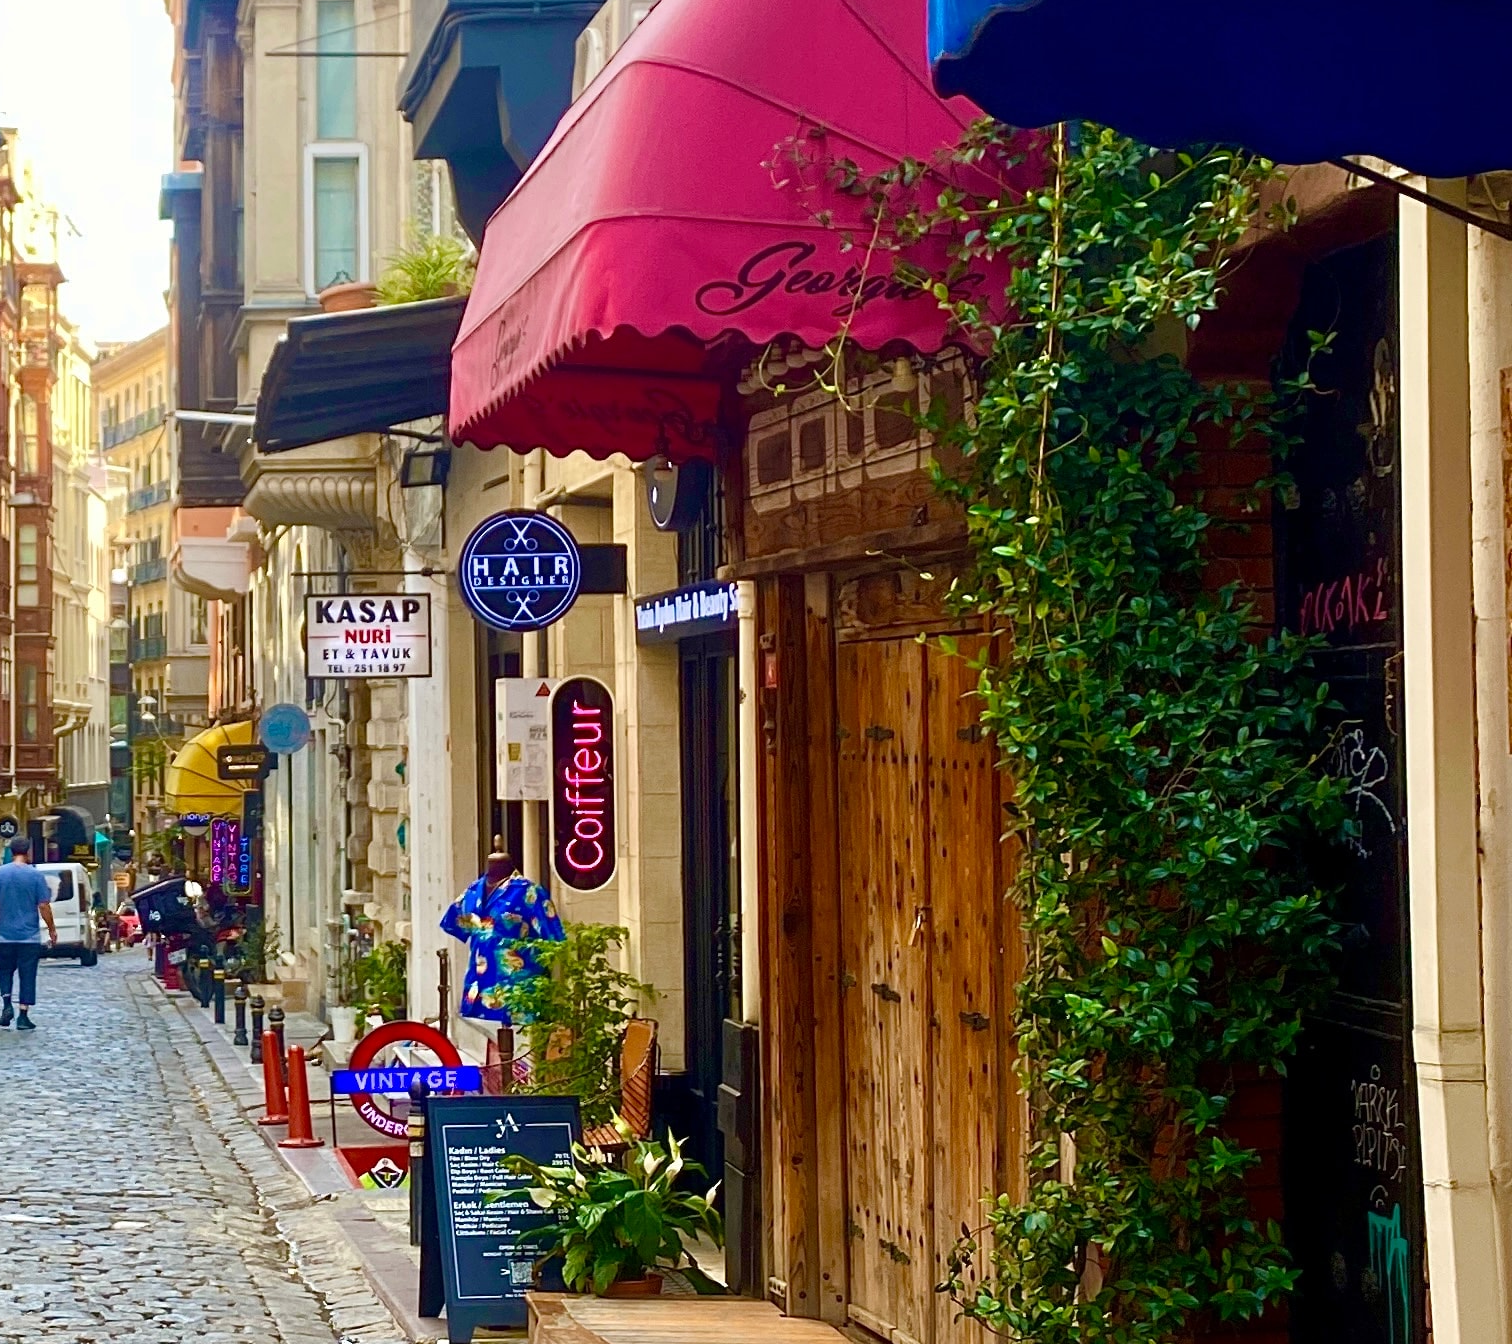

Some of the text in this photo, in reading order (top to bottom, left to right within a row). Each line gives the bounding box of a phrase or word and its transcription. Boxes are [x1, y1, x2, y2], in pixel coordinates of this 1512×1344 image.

[473, 556, 568, 576] HAIR
[473, 575, 569, 586] DESIGNER
[315, 599, 420, 624] KASAP
[699, 587, 728, 621] Beauty
[345, 624, 391, 644] NURİ
[323, 647, 411, 660] ET & TAVUK
[354, 664, 373, 673] 251
[378, 664, 389, 672] 18
[393, 663, 406, 672] 97
[565, 699, 604, 869] Coiffeur
[213, 822, 221, 882] VINTAGE
[479, 1146, 506, 1154] Ladies
